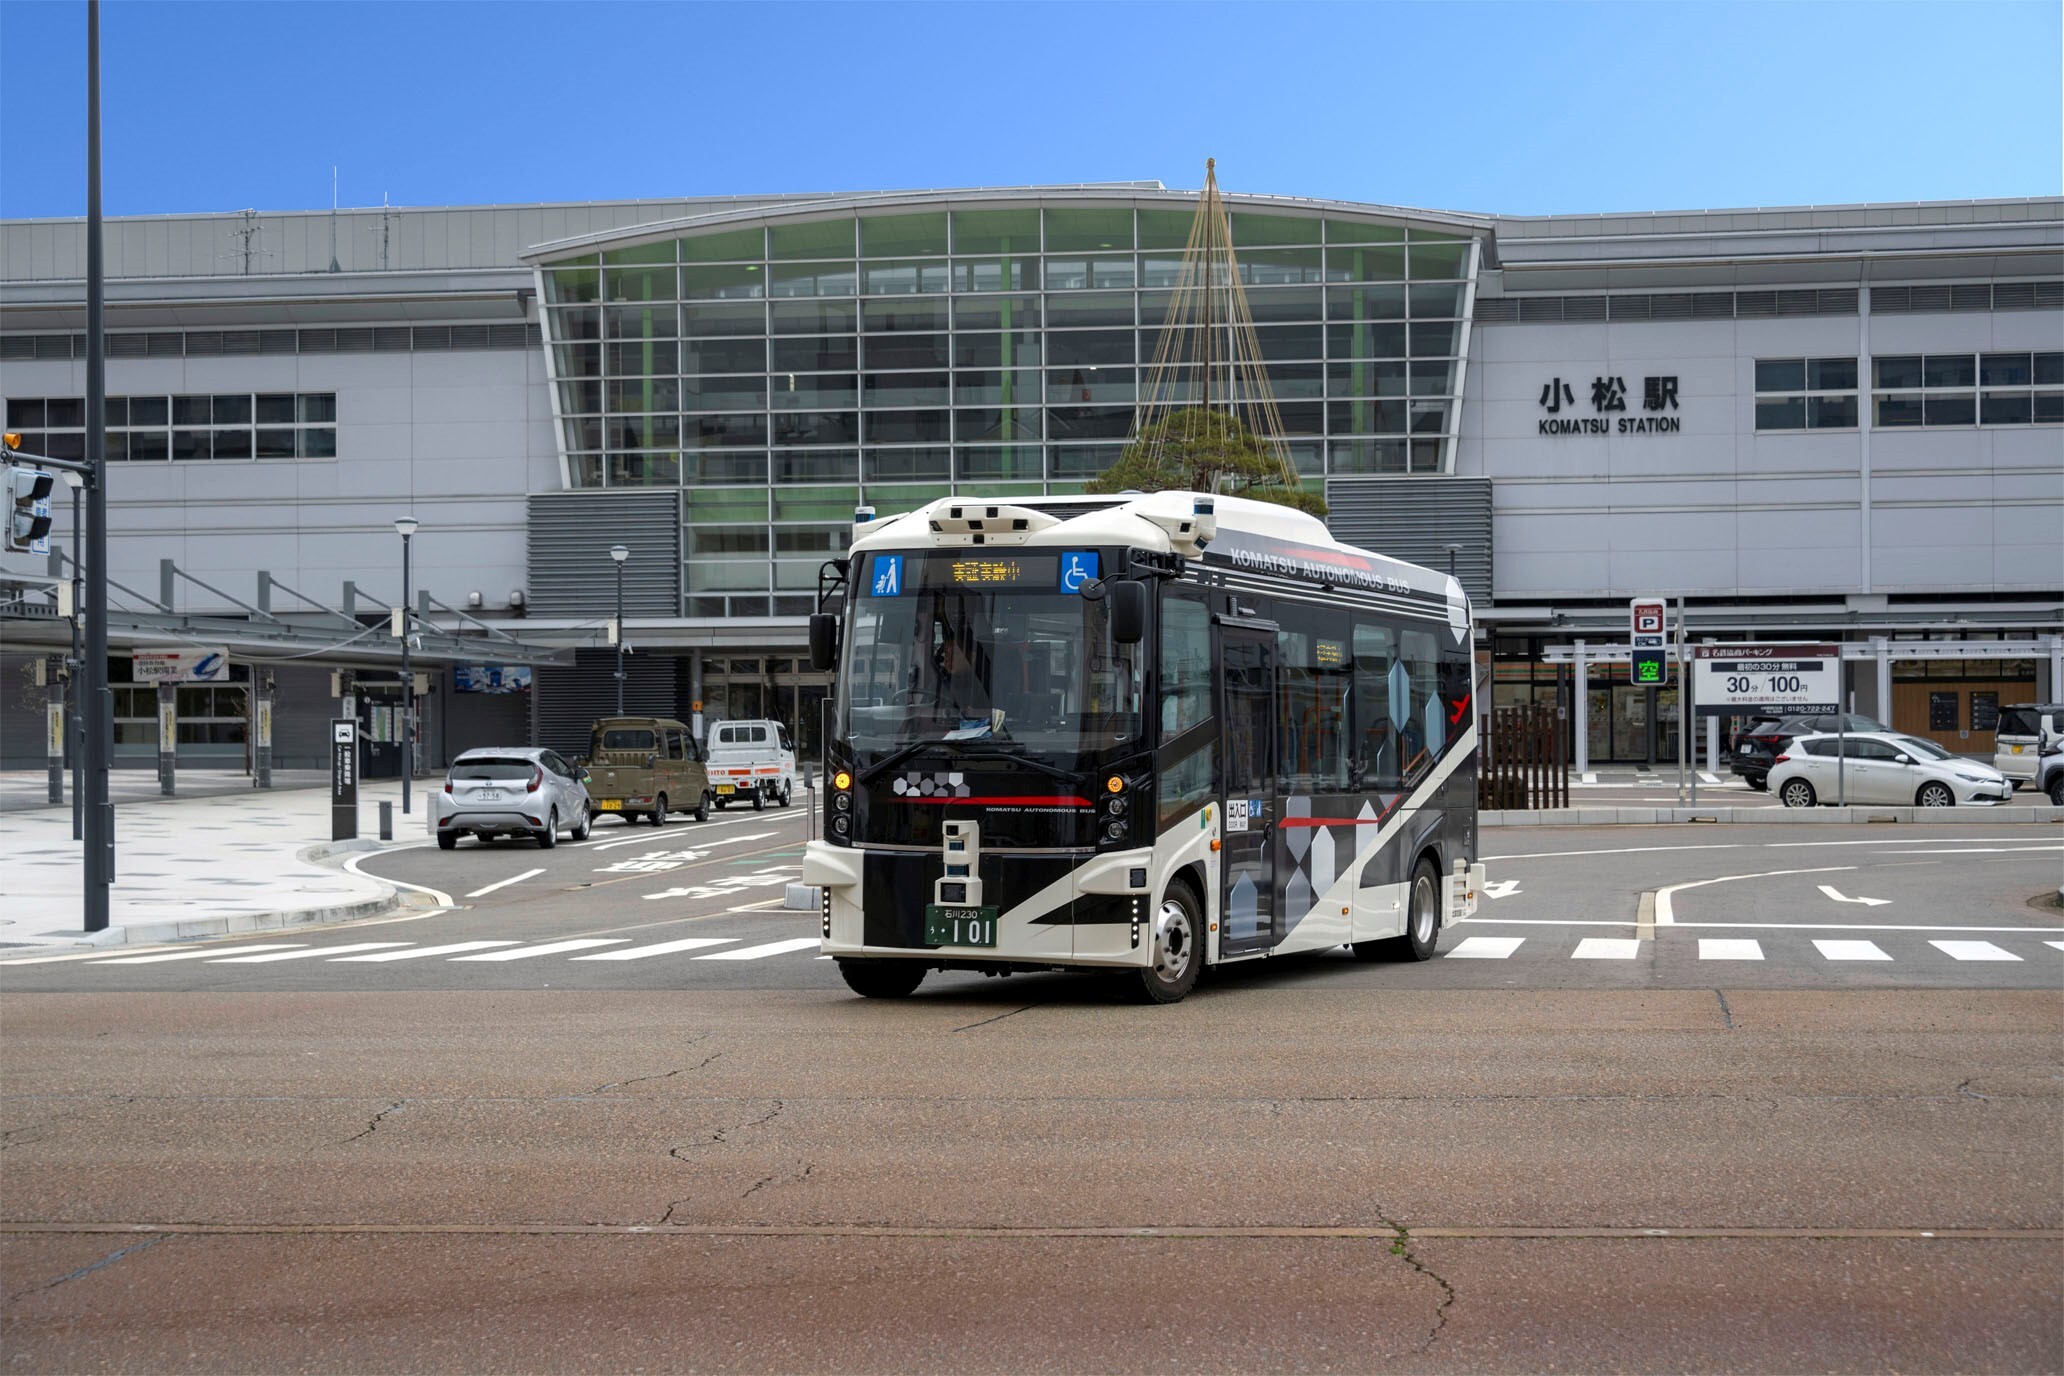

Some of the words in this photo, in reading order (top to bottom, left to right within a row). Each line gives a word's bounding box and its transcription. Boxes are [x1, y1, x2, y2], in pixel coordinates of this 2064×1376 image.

[1539, 376, 1679, 413] 小松駅
[1539, 418, 1609, 434] KOMATSU
[1618, 417, 1680, 433] STATION
[952, 561, 1020, 581] 実証実験中
[1230, 547, 1297, 575] KOMATSU
[1302, 561, 1384, 589] AUTONOMOUS
[1388, 576, 1411, 594] BUS
[1643, 618, 1655, 628] P
[1639, 660, 1659, 681] 空
[1228, 803, 1247, 818] 出入口
